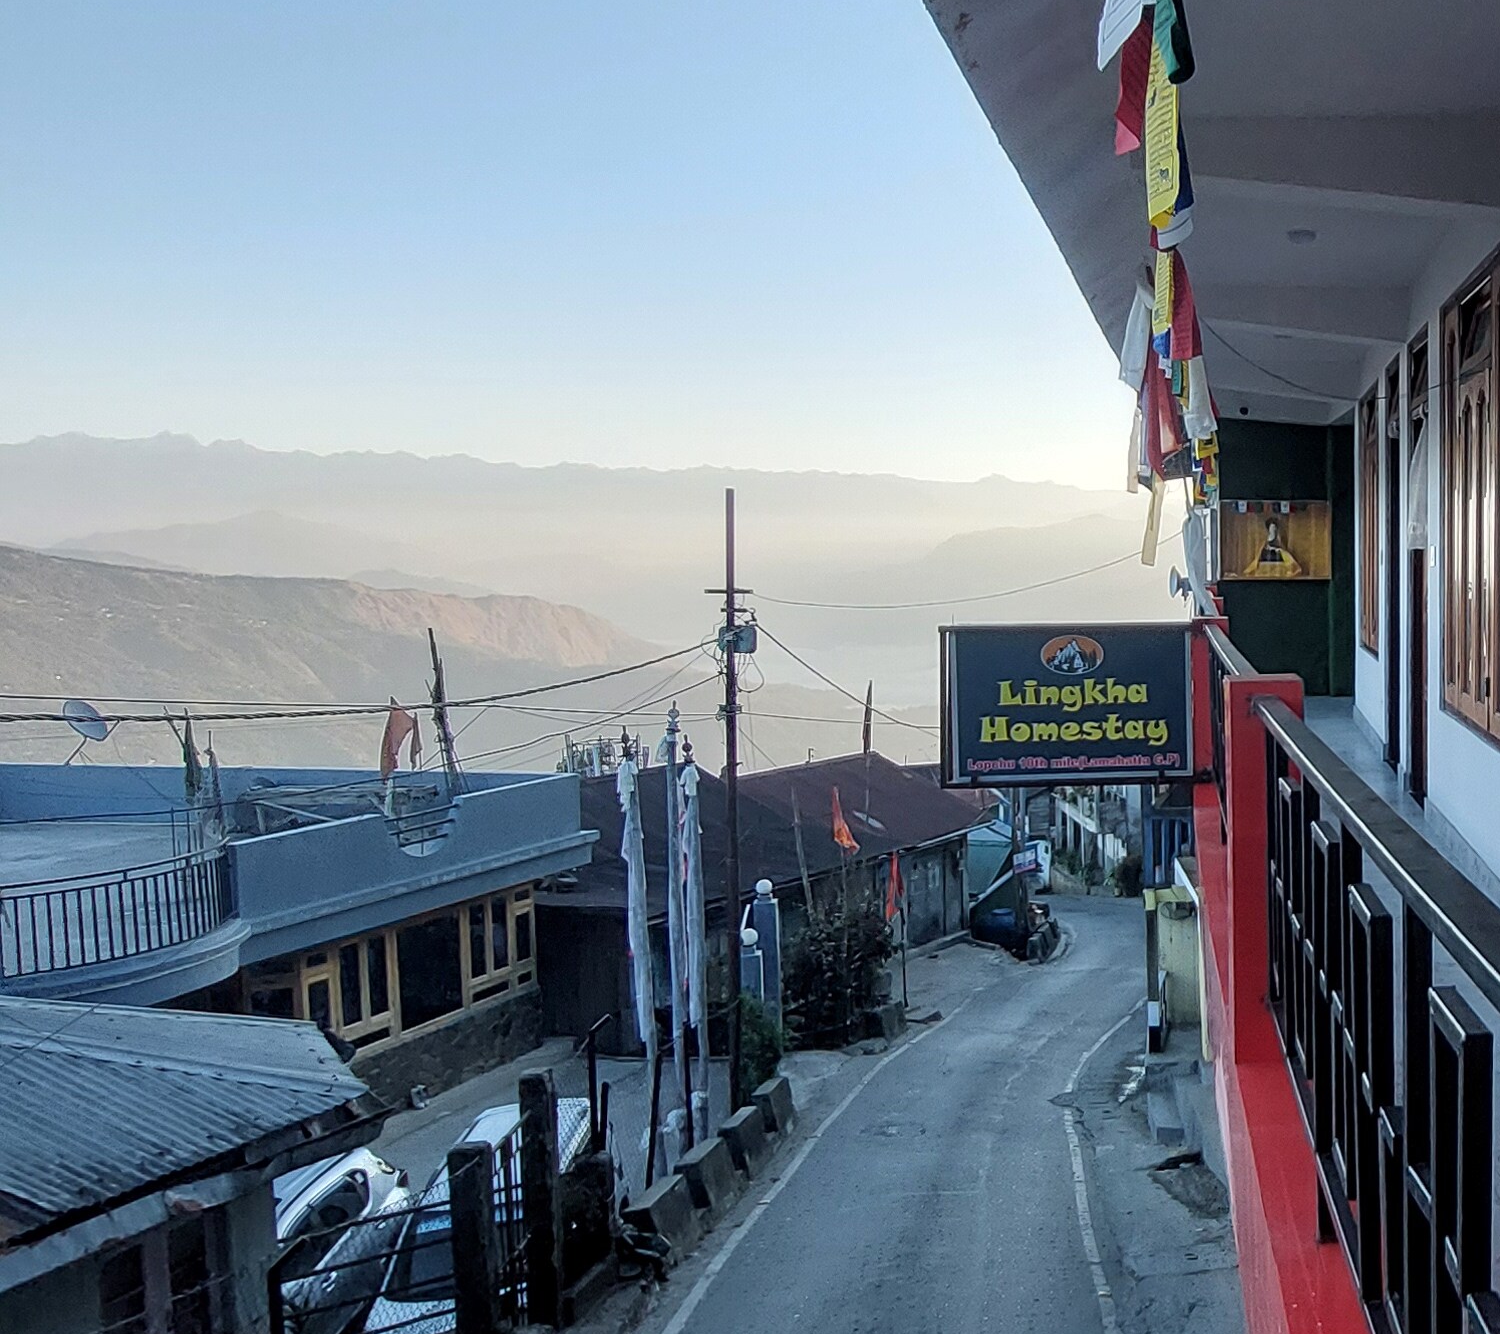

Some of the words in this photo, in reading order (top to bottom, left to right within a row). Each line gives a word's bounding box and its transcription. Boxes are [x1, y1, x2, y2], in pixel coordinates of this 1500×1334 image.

[996, 677, 1149, 712] Lingkha
[979, 713, 1168, 746] Homestay
[1019, 756, 1048, 770] 10th
